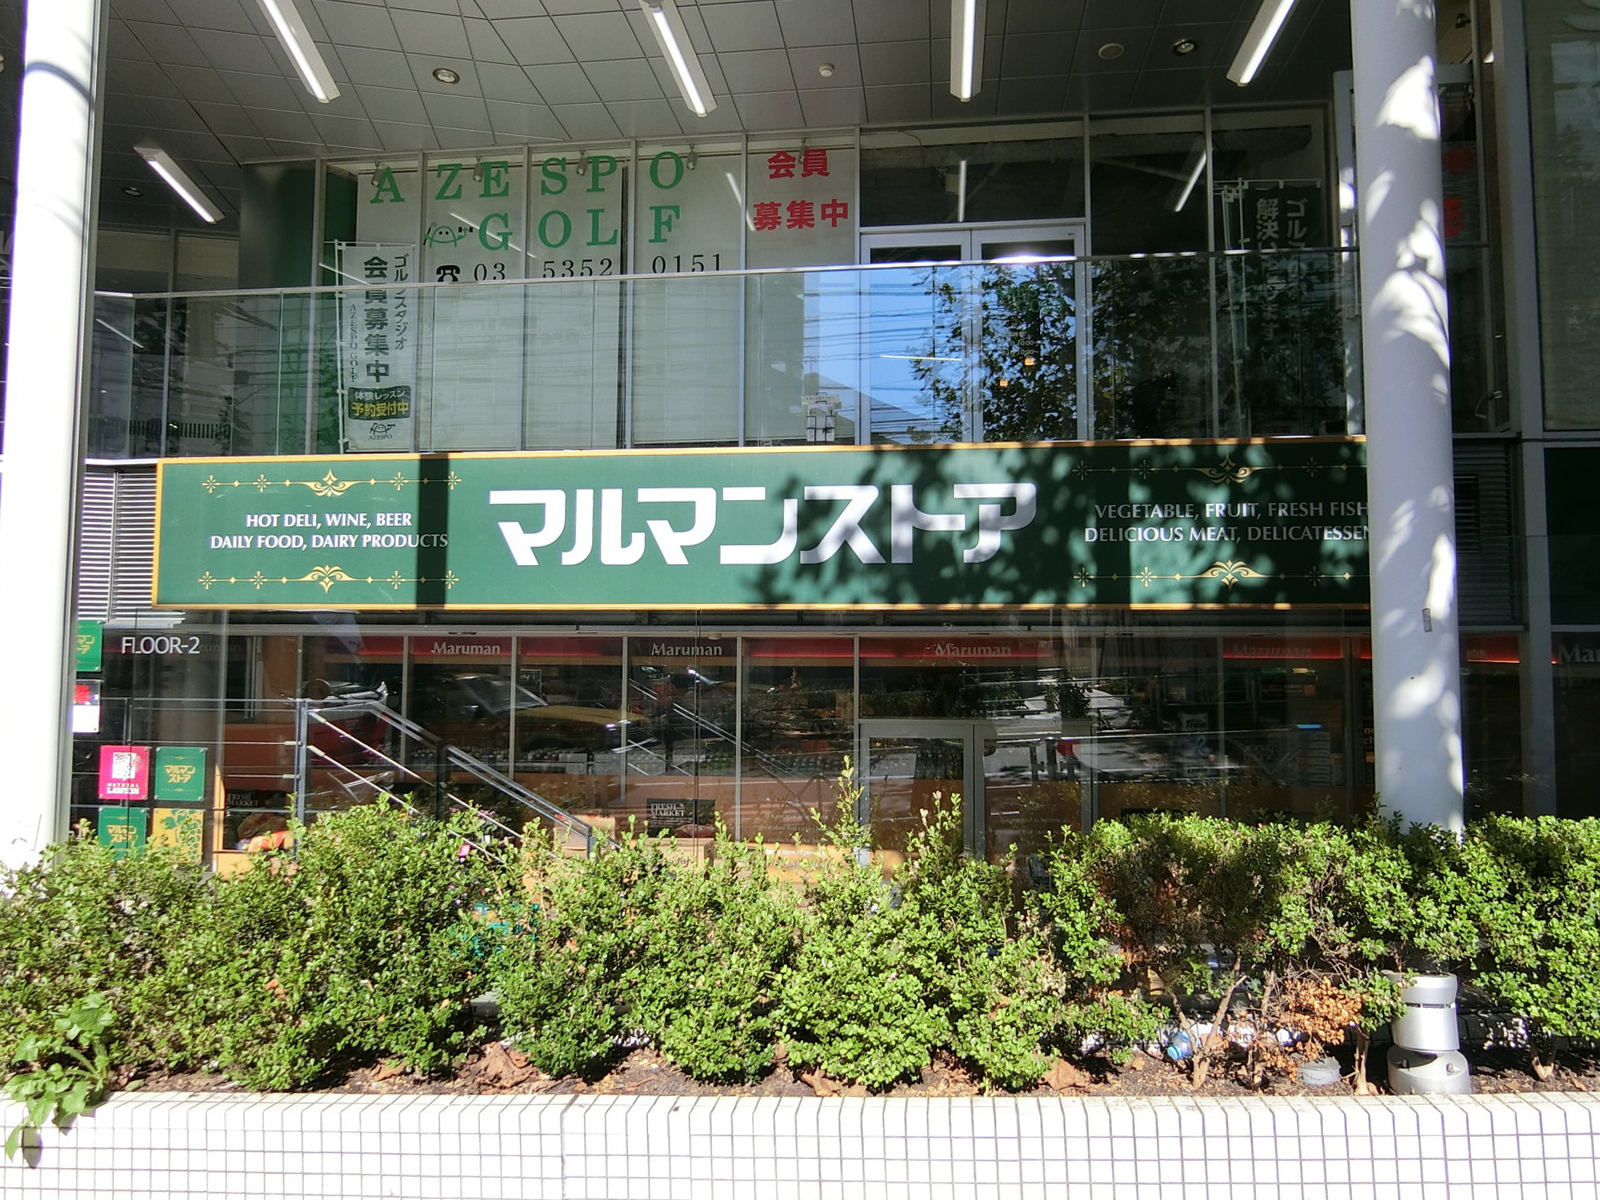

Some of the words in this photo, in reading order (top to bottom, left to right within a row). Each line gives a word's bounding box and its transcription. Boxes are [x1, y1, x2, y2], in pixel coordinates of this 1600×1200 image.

[768, 149, 829, 179] 会員
[370, 151, 684, 204] AZESPO
[753, 199, 848, 231] 募集中
[478, 205, 681, 251] GOLF
[474, 263, 506, 281] 03
[542, 258, 613, 279] 5352
[652, 254, 721, 274] 0151
[363, 255, 390, 383] 会員募集中
[352, 402, 409, 417] 予約受付中
[1095, 503, 1199, 521] VEGETABLE,
[1205, 502, 1262, 520] FRUIT,
[1268, 501, 1323, 517] FRESH
[246, 514, 280, 527] HOT
[284, 514, 322, 529] DELI,
[325, 513, 371, 529] WINE,
[376, 513, 412, 527] BEER
[489, 483, 1037, 566] マルマンストア
[211, 535, 253, 549] DAILY
[257, 535, 307, 550] FOOD,
[312, 534, 358, 548] DAIRY
[362, 533, 448, 547] PRODUCTS
[1084, 527, 1184, 542] DELICIOUS
[1189, 526, 1242, 544] MEAT,
[121, 636, 201, 655] FLOOR-2
[432, 641, 501, 655] Maruman
[650, 641, 723, 656] Maruman
[935, 642, 1012, 656] Maruman
